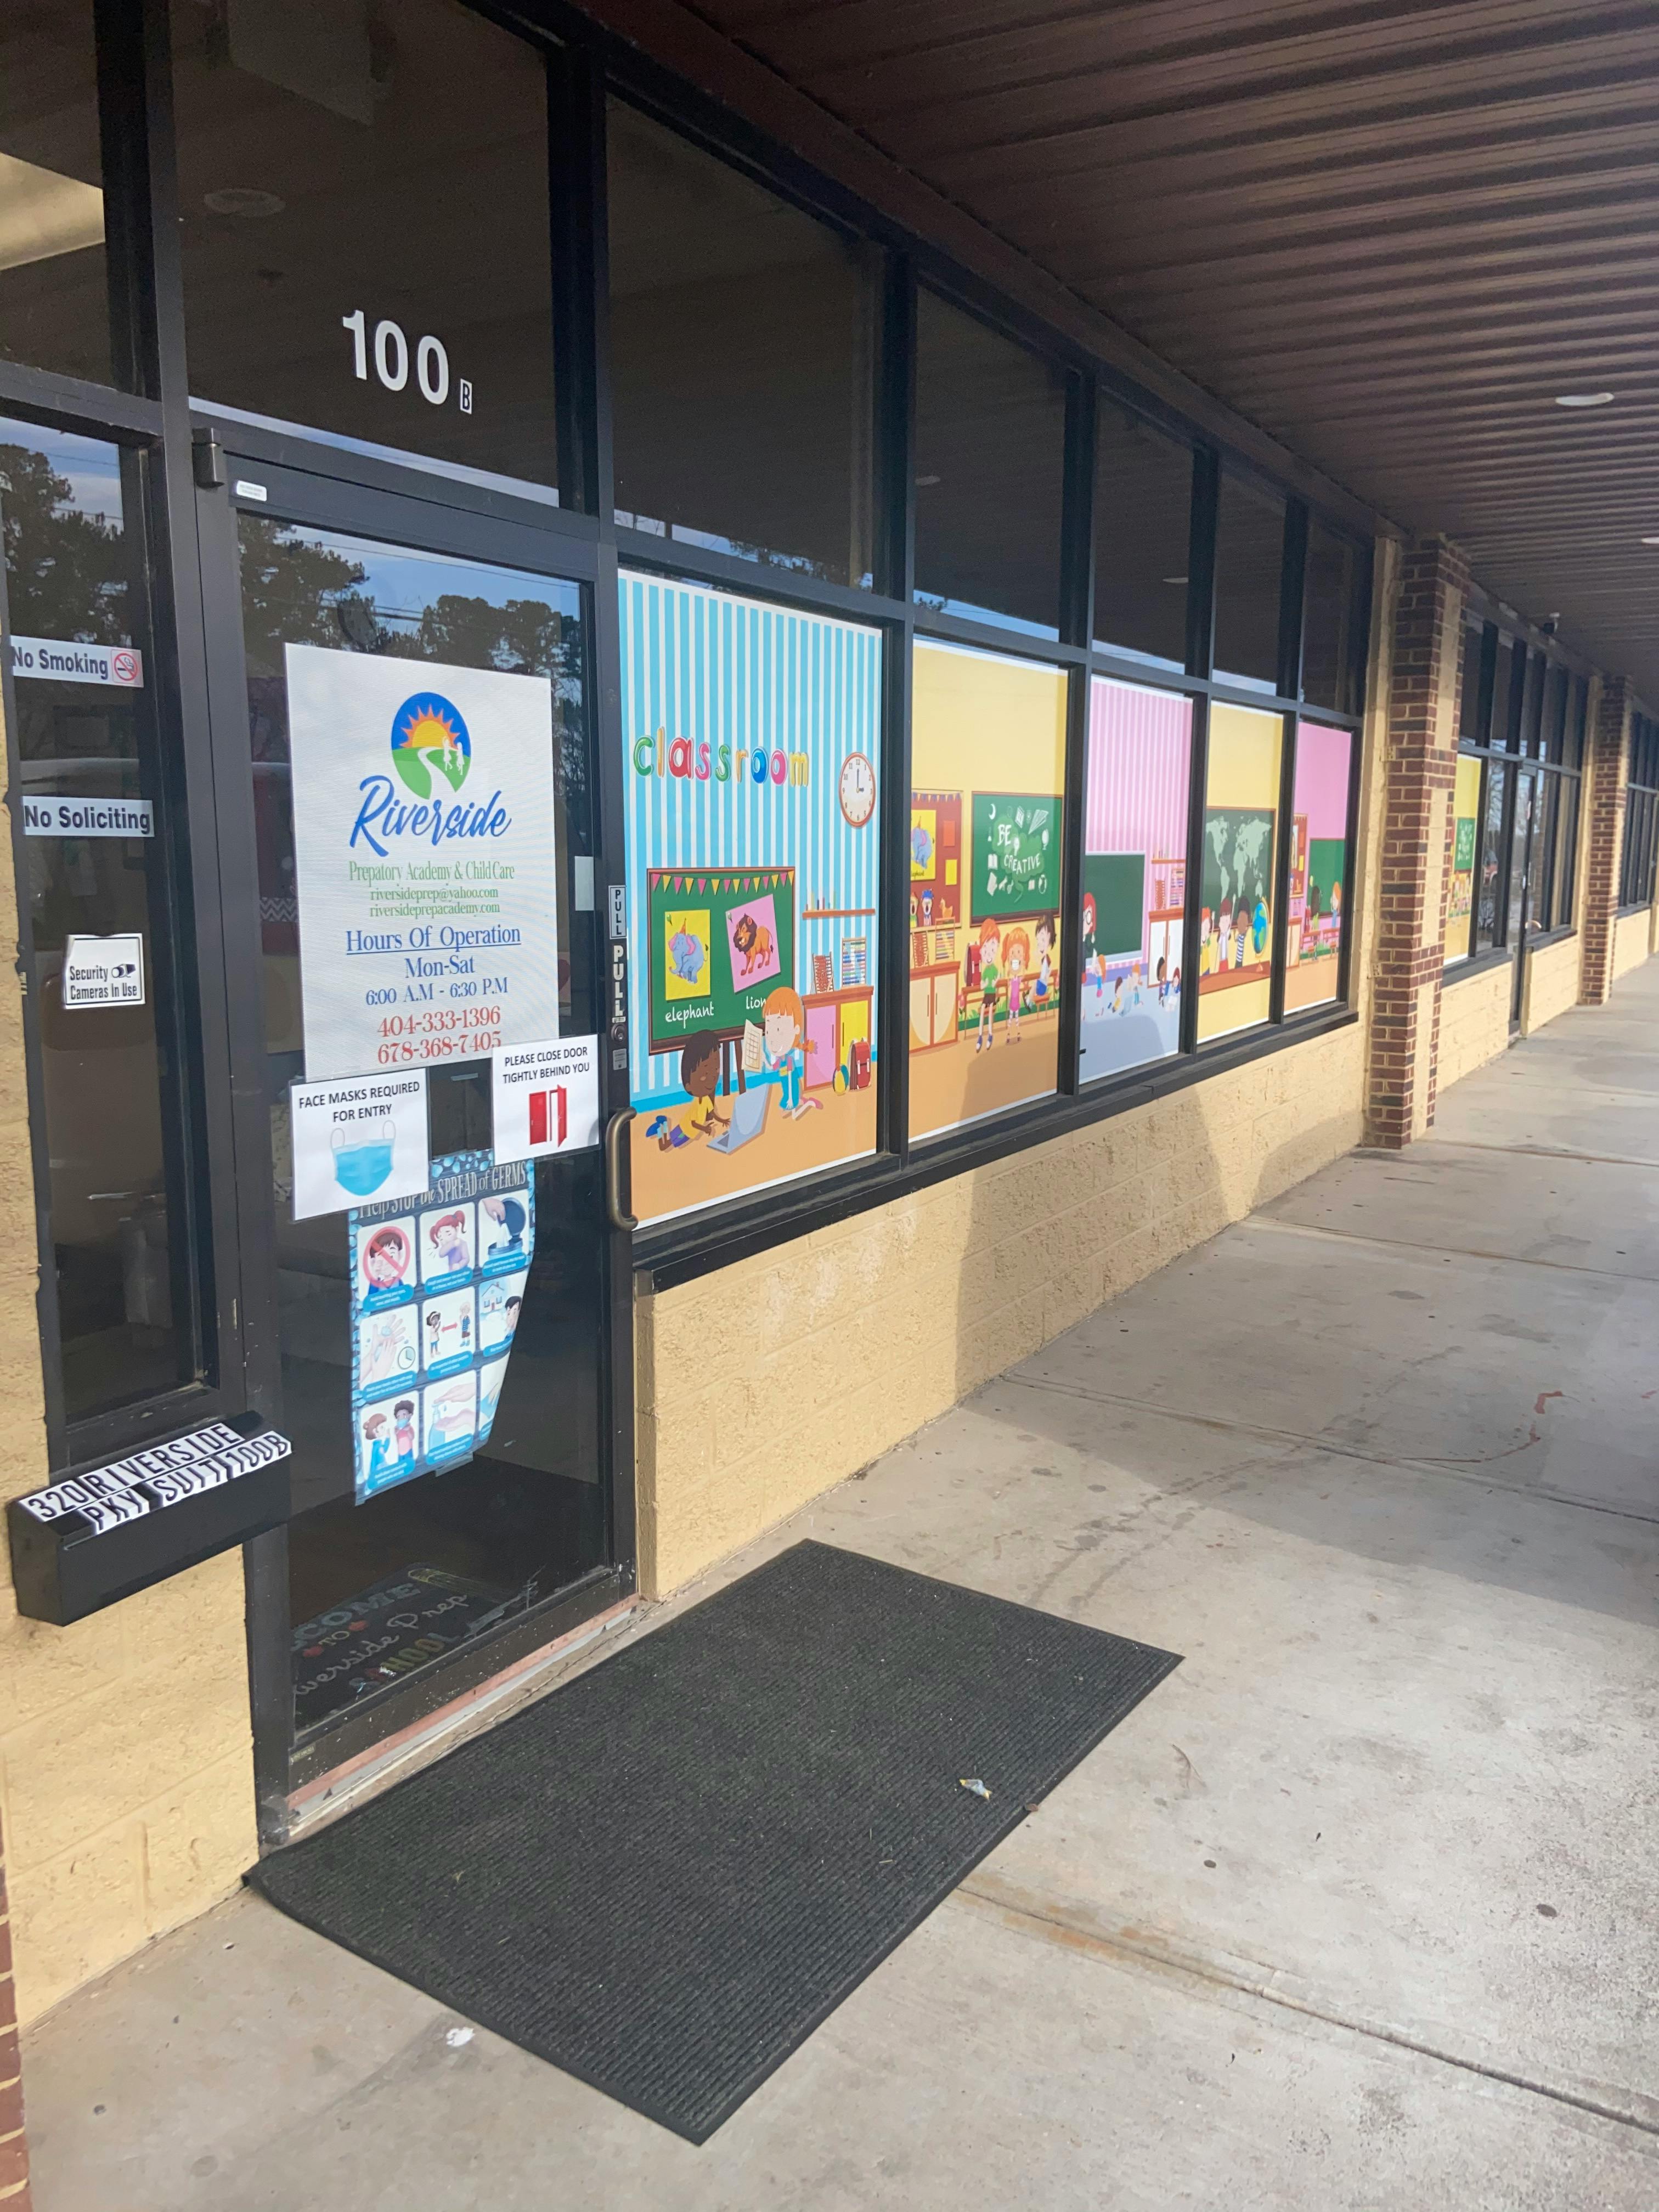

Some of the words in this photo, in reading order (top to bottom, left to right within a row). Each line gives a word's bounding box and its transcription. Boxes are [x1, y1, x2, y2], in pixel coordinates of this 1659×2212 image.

[342, 309, 449, 405] 100
[461, 381, 471, 411] B
[13, 646, 34, 668] No
[39, 648, 109, 680] Smoking
[633, 727, 810, 787] classroom
[24, 805, 52, 828] No
[59, 806, 150, 834] Soliciting
[349, 775, 512, 857] Riverside
[997, 824, 1012, 847] BE
[349, 862, 402, 887] Prepatory
[407, 861, 452, 886] Academy
[454, 861, 463, 881] &
[466, 861, 491, 879] Child
[493, 861, 515, 879] Care
[1004, 853, 1041, 874] CREATIVE
[370, 887, 499, 904] riversideprep@yahoo.com
[369, 902, 500, 919] riversideprepacademy.com
[346, 930, 402, 952] Hours
[409, 925, 433, 948] Of
[440, 924, 521, 952] Operation
[70, 965, 108, 982] Security
[404, 955, 476, 979] Mon-Sat
[613, 945, 624, 1017] PULL
[70, 985, 109, 1000] Cameras
[111, 983, 120, 997] In
[122, 983, 137, 997] Use
[366, 988, 397, 1006] 6:00
[404, 983, 434, 1002] A.M
[450, 981, 477, 998] 6:30
[482, 977, 508, 995] P.M
[746, 996, 766, 1009] lion
[377, 1006, 501, 1037] 404-333-1396
[665, 1001, 714, 1029] elephant
[377, 1031, 501, 1064] 678-368-7405
[505, 1053, 535, 1066] PLEASE
[537, 1050, 562, 1062] CLOSE
[564, 1047, 588, 1058] DOOR
[503, 1070, 538, 1084] TIGHTLY
[540, 1065, 571, 1079] BEHIND
[573, 1062, 590, 1073] YOU
[299, 1094, 325, 1109] FACE
[329, 1089, 367, 1104] MASKS
[370, 1081, 420, 1098] REQUIRED
[333, 1110, 355, 1122] FOR
[359, 1104, 392, 1119] ENTRY
[438, 1171, 478, 1204] SPREAD
[478, 1171, 489, 1190] of
[492, 1160, 527, 1190] GERMS
[28, 1484, 89, 1518] 320
[83, 1425, 241, 1496] RIVERSIDE
[83, 1490, 143, 1532] PKY
[225, 1434, 289, 1473] 100B
